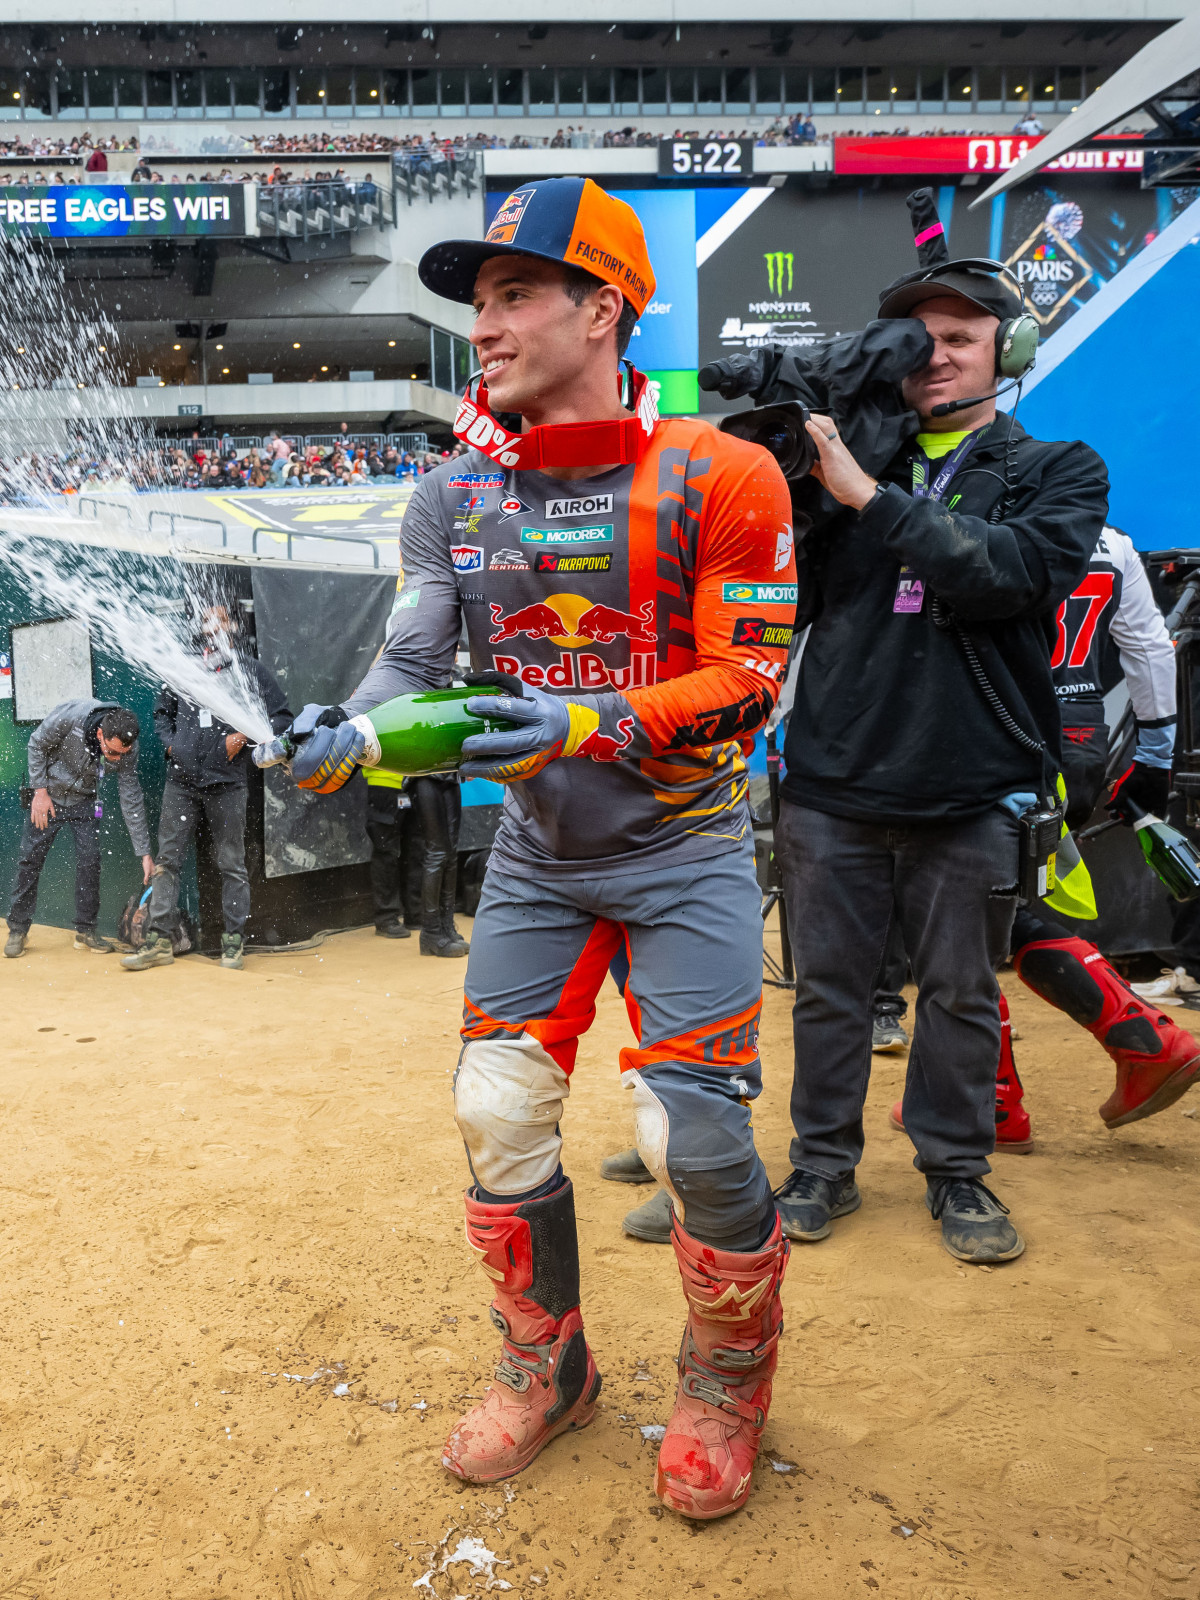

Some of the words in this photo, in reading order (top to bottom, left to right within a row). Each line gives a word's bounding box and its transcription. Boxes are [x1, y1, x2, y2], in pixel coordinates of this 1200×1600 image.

[671, 141, 743, 175] 5:22
[64, 197, 166, 223] EAGLES
[172, 196, 231, 221] WIFI
[575, 240, 626, 276] FACTORY
[624, 266, 649, 302] RACING
[1017, 260, 1074, 282] PARIS
[748, 301, 812, 314] MONSTER
[181, 406, 199, 415] 112
[447, 481, 504, 489] UNLIMITED
[448, 473, 505, 484] PARTS
[550, 496, 609, 516] AIROH
[546, 527, 607, 542] MOTOREX
[488, 563, 531, 571] RENTHAL
